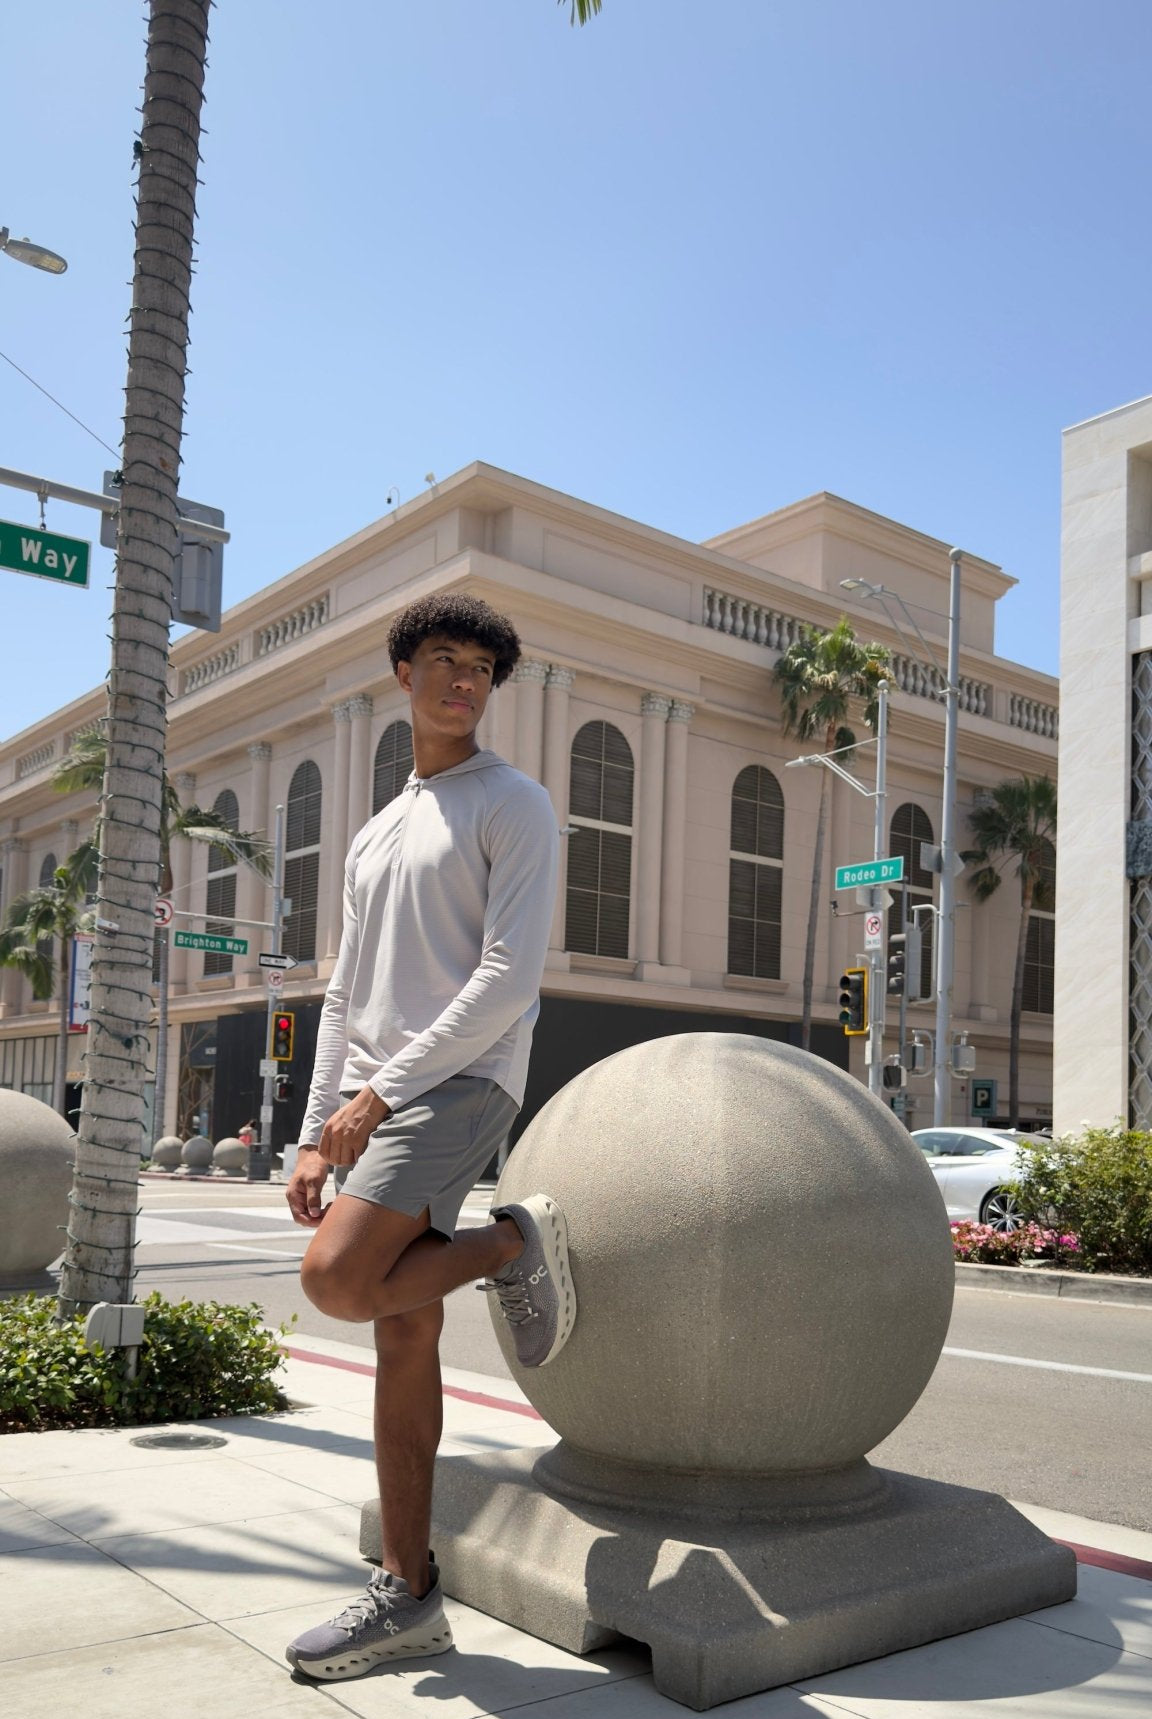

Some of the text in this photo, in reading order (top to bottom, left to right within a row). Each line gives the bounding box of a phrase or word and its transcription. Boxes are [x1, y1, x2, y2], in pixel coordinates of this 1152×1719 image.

[21, 538, 78, 578] Way
[844, 865, 894, 883] Rodeo Dr
[177, 935, 245, 953] Brighton Way
[976, 1089, 989, 1107] P
